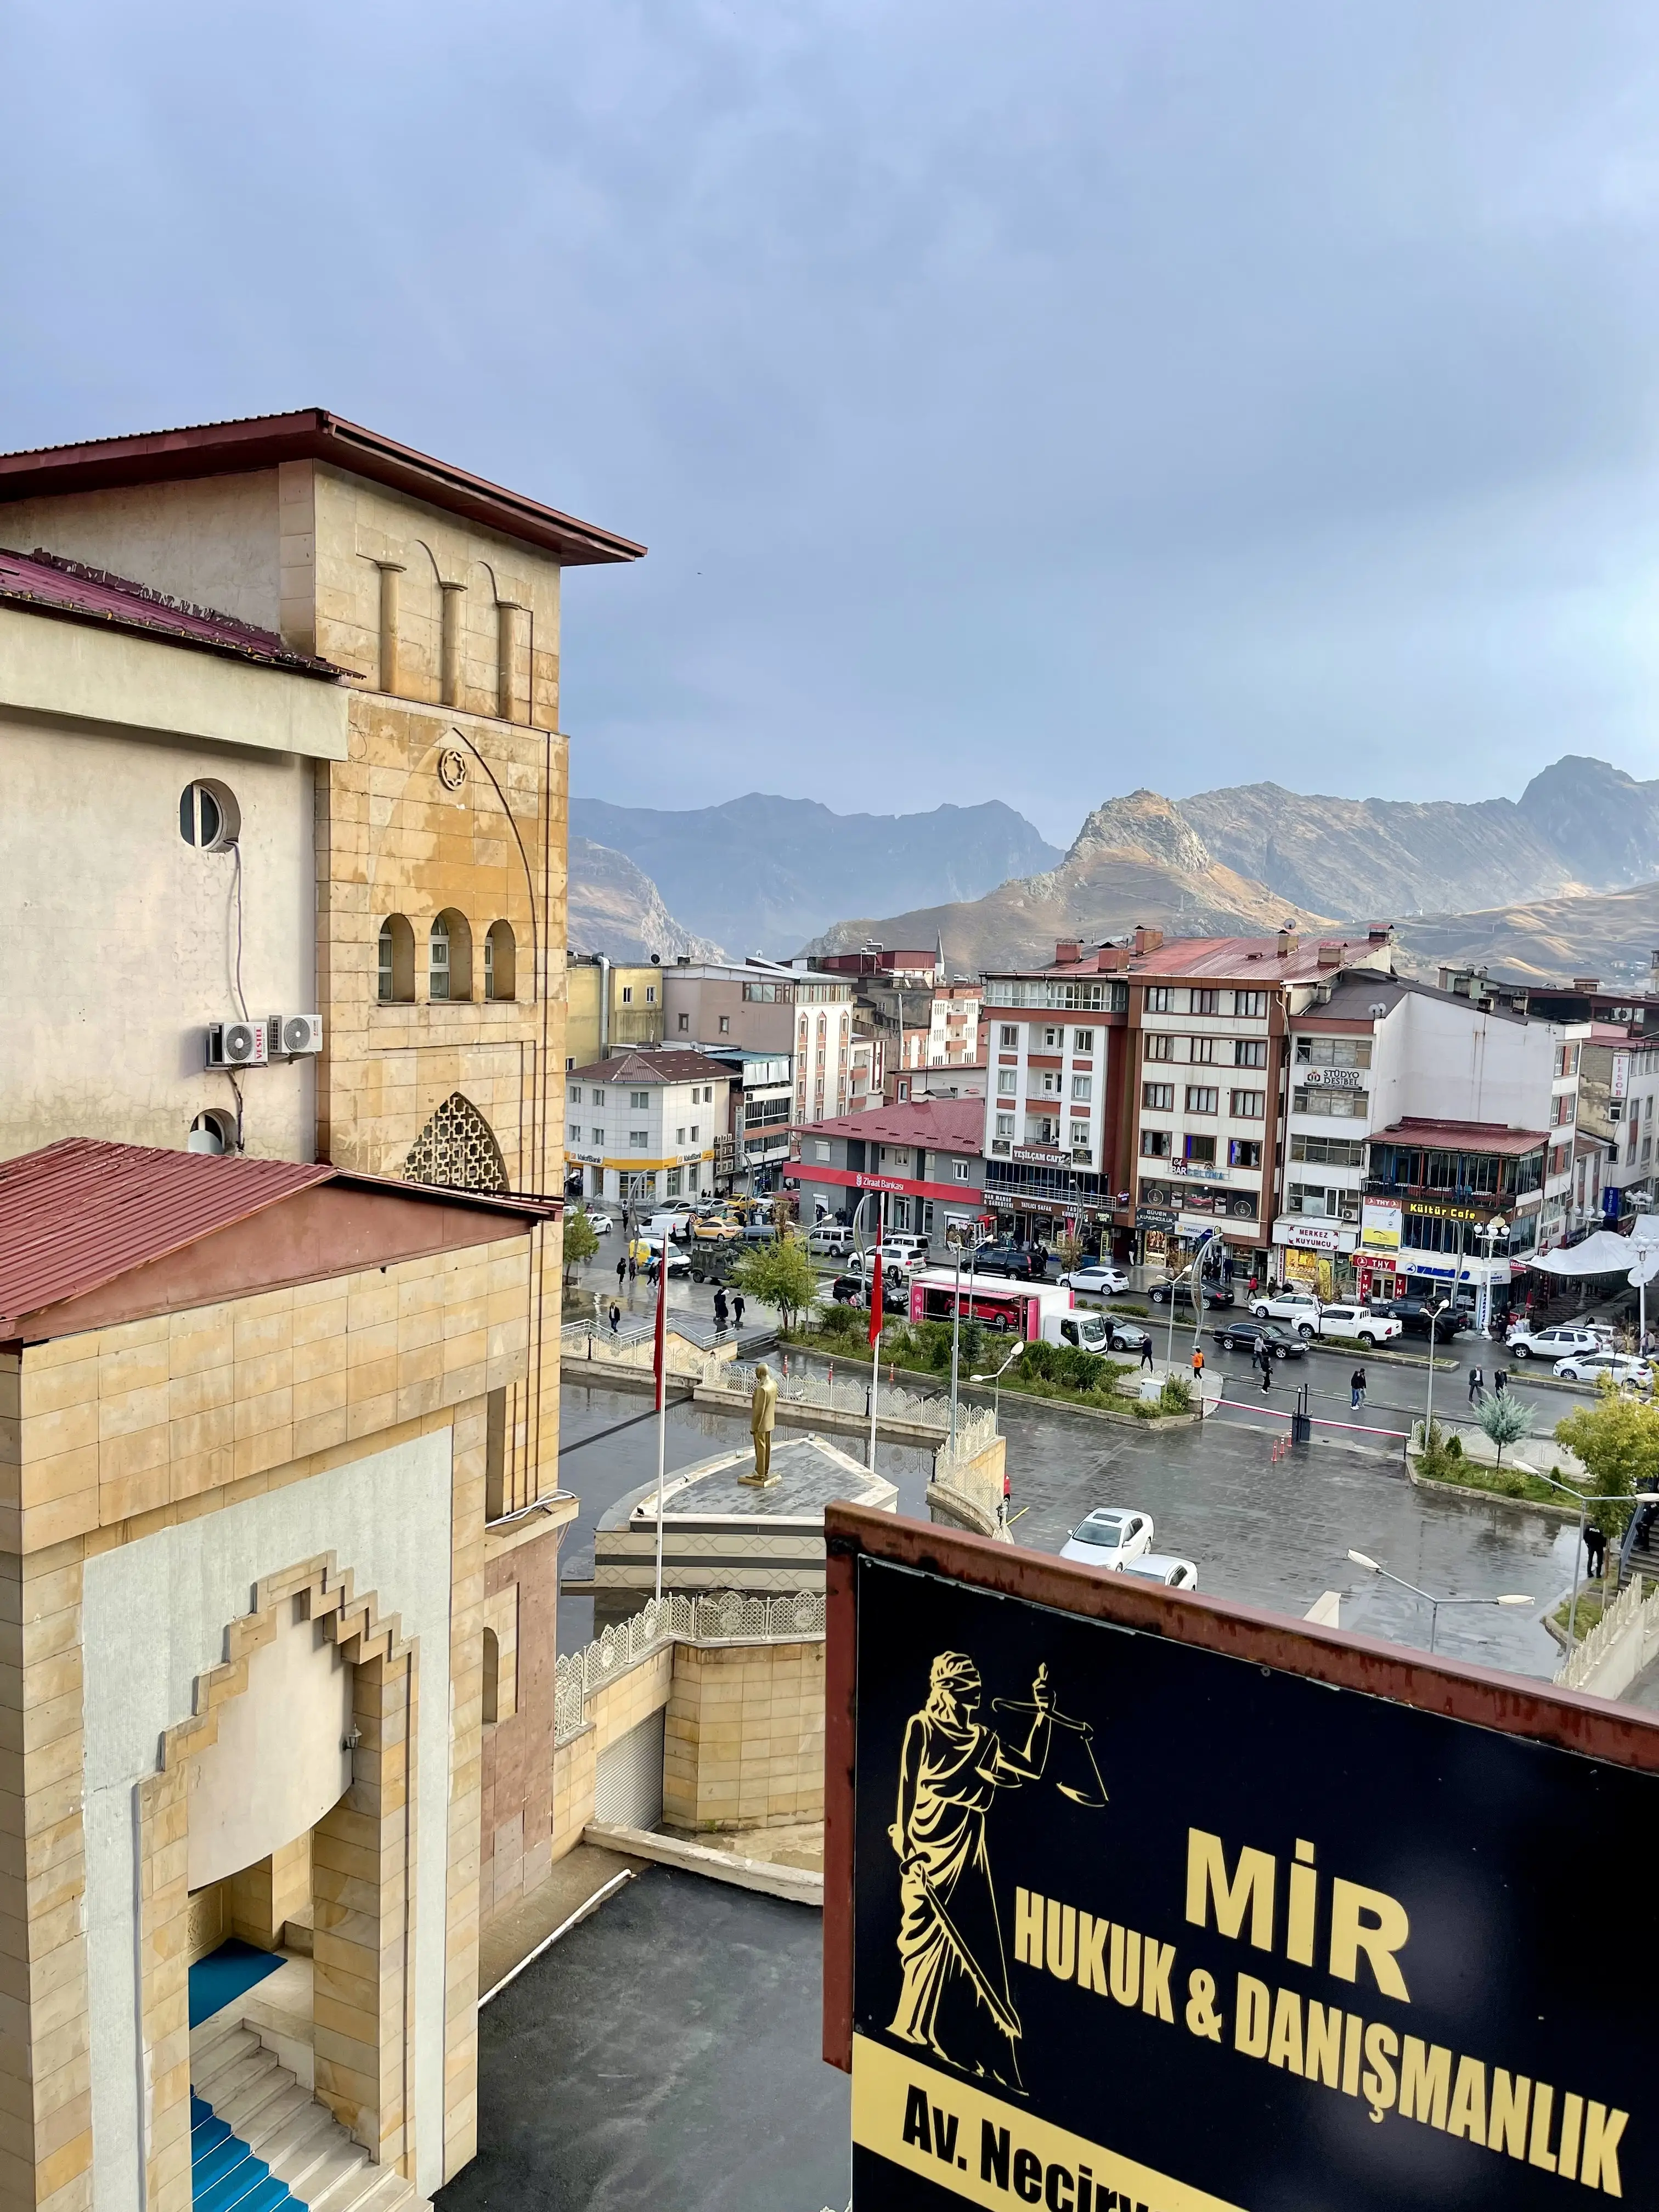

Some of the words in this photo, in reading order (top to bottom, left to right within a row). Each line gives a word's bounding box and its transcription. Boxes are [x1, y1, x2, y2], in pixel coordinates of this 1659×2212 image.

[1323, 1069, 1359, 1079] STÜDYO
[1014, 1150, 1045, 1161] YEŞİLÇAM
[863, 1177, 880, 1188] Ziraat
[881, 1180, 904, 1190] Bankası
[1410, 1203, 1447, 1216] Kültür
[1450, 1208, 1476, 1220] Cafe
[1139, 1215, 1173, 1223] KUYUMCULUK
[1300, 1229, 1328, 1238] MERKEZ
[1296, 1238, 1331, 1248] KUYUMCU
[1372, 1260, 1390, 1268] THY
[1186, 1827, 1409, 2004] MİR
[1014, 1886, 1176, 2025] HUKUK
[1186, 1968, 1222, 2044] &
[1234, 1971, 1630, 2198] DANIŞMANLIK
[902, 2083, 967, 2171] Av.
[980, 2118, 1162, 2212] Necir
